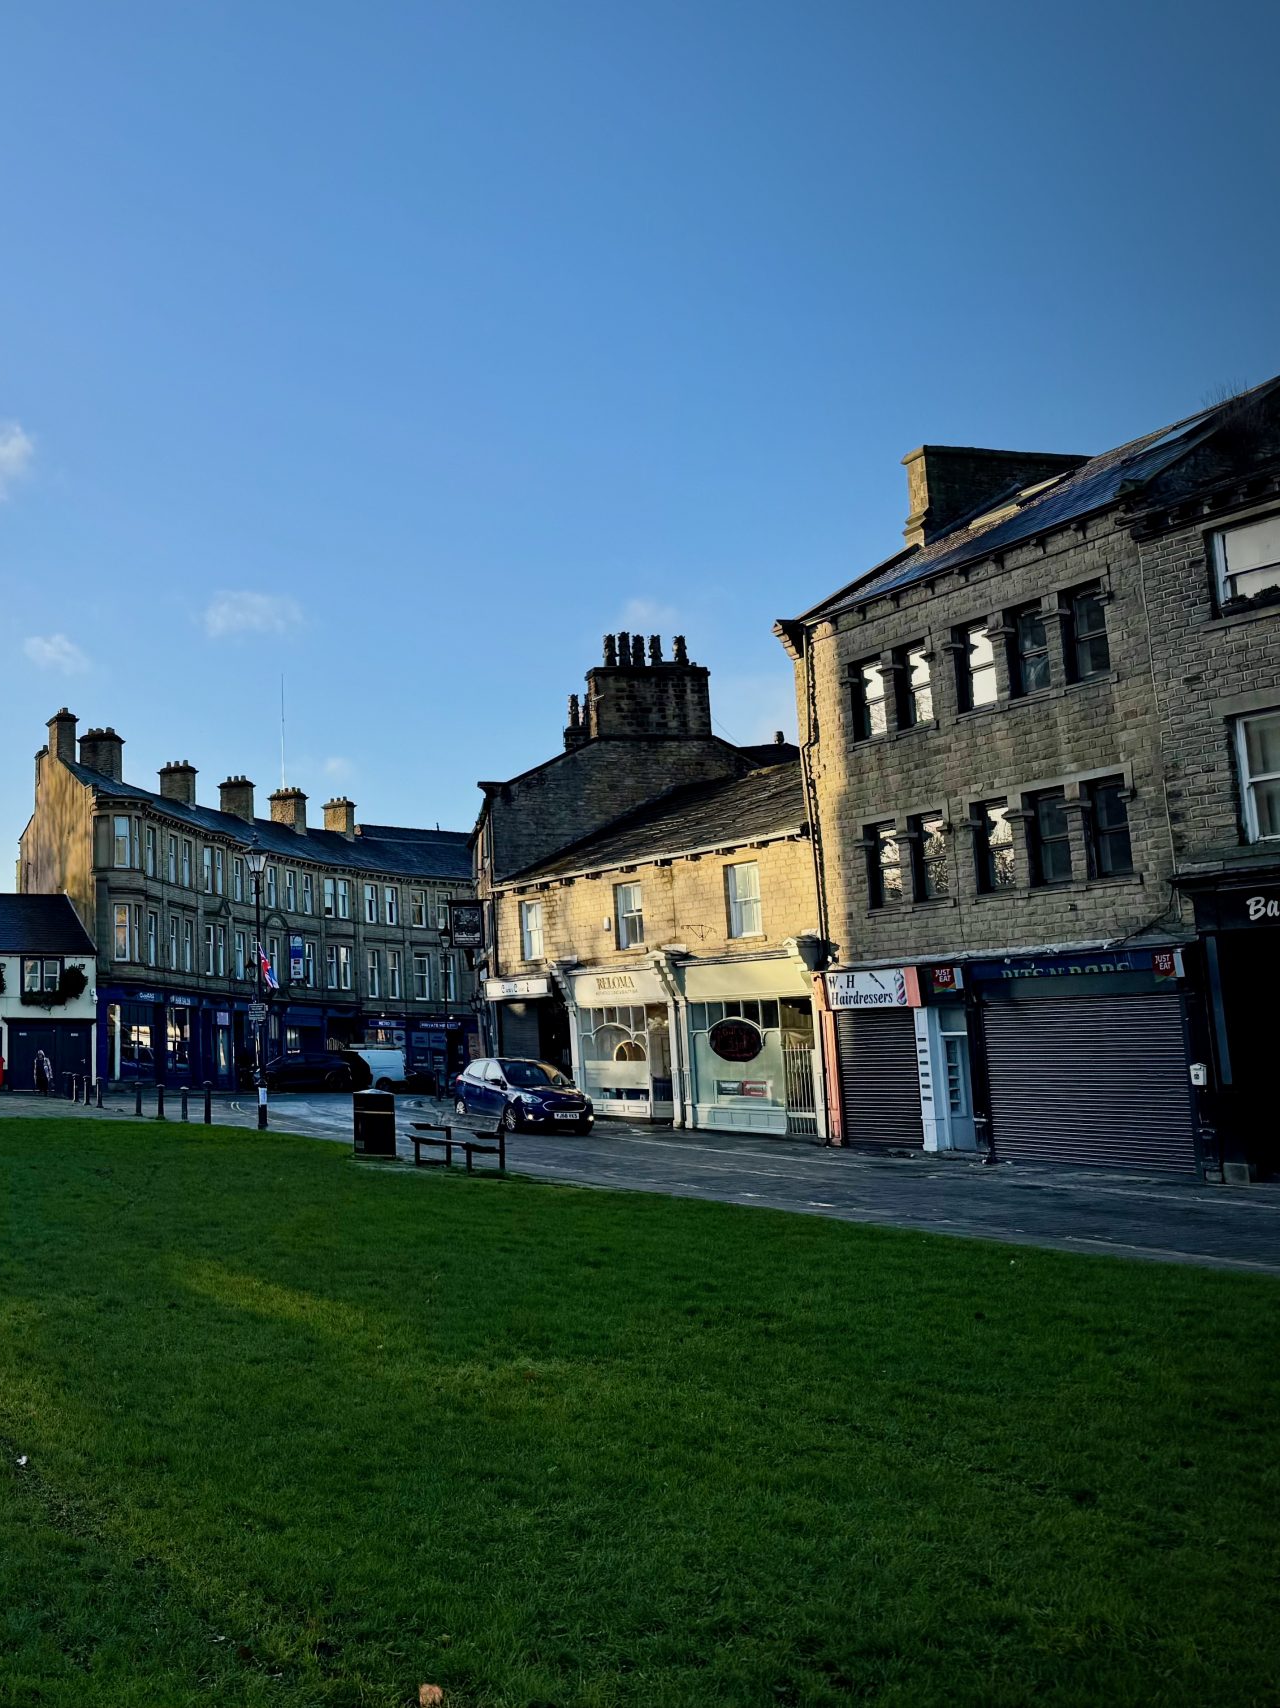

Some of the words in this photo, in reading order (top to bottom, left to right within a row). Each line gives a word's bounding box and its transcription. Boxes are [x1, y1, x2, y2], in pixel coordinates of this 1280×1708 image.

[1154, 954, 1170, 964] JUST
[1159, 962, 1172, 970] EAT
[935, 968, 951, 977] JUST
[939, 975, 951, 983] EAT
[831, 991, 893, 1005] Hairdressers
